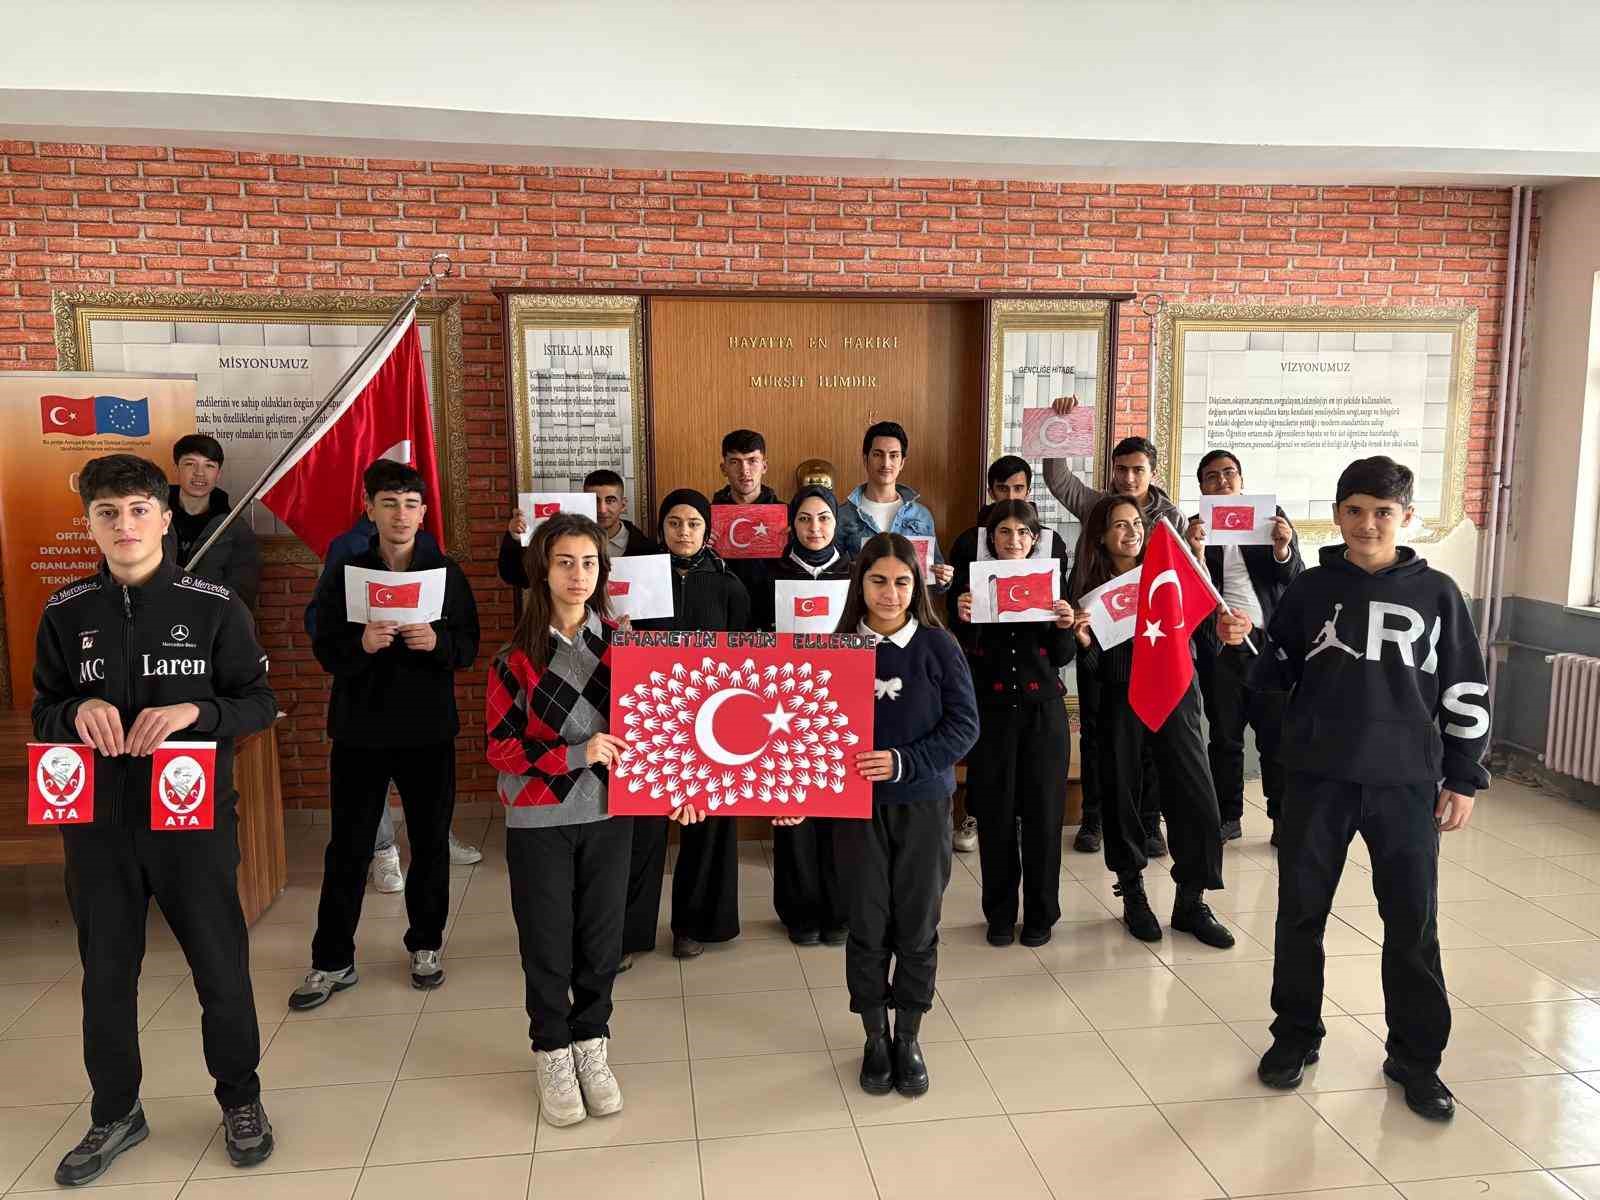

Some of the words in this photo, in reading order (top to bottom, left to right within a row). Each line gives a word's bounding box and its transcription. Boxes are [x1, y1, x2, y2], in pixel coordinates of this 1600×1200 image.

[728, 336, 794, 349] HAYATTA
[808, 337, 828, 349] EN
[219, 357, 309, 369] MİSYONUMUZ
[1281, 361, 1351, 372] VİZYONUMUZ
[232, 400, 240, 408] ve
[241, 397, 260, 410] sahip
[261, 397, 292, 408] oldukları
[192, 578, 230, 597] Mercedes
[727, 629, 776, 648] EMİN
[792, 634, 876, 650] ELLERDE
[79, 658, 105, 684] MC
[142, 654, 206, 676] Laren
[43, 808, 79, 820] ATA
[164, 816, 200, 827] ATA
